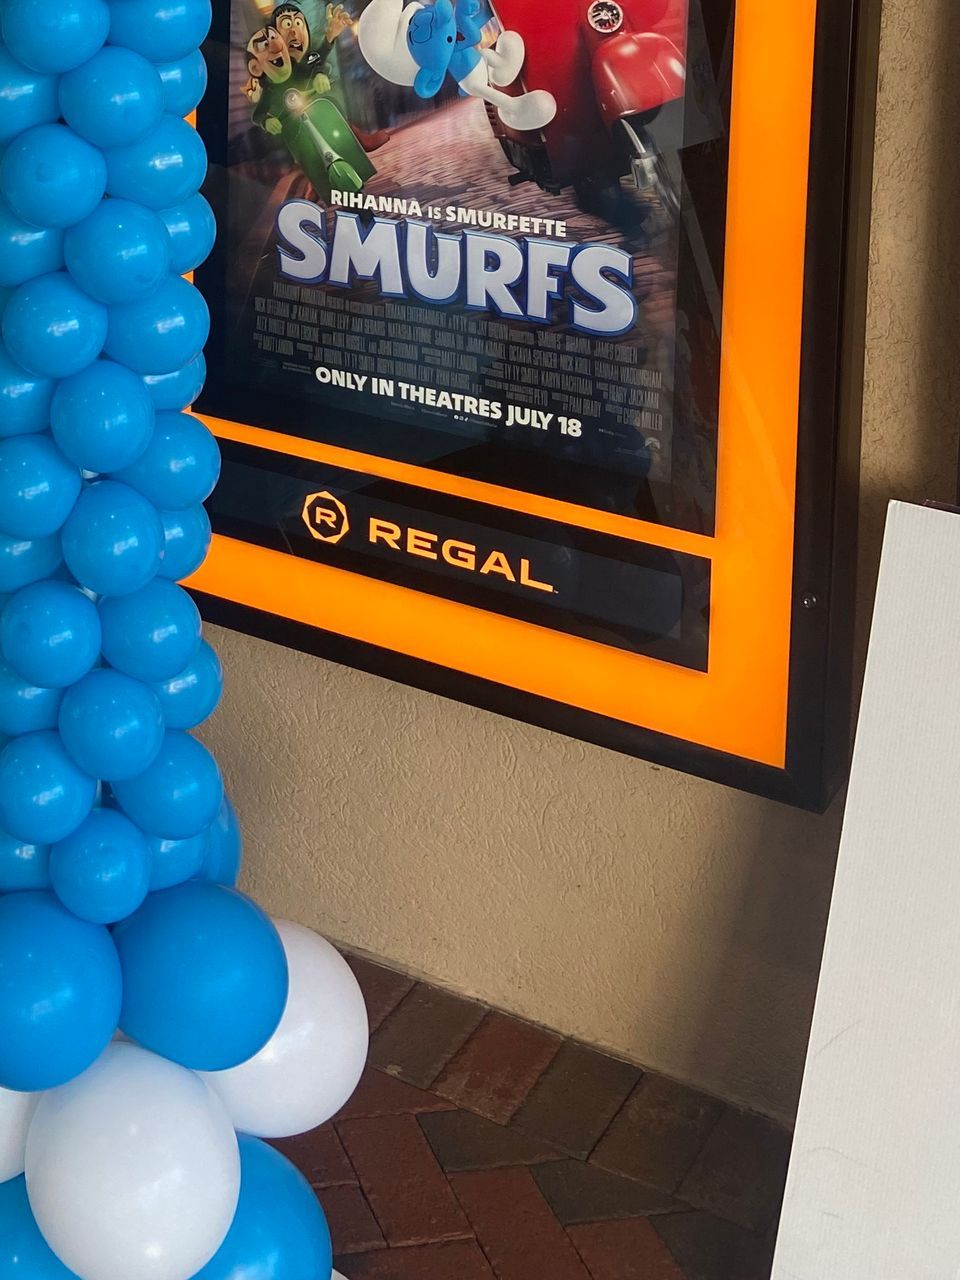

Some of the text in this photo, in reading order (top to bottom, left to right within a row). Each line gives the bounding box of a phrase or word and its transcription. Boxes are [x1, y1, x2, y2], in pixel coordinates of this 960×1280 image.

[330, 189, 422, 217] RIHANNA
[445, 206, 567, 238] SMURFETTE
[275, 198, 640, 337] SMURFS
[315, 366, 368, 391] ONLY
[371, 377, 395, 397] IN
[398, 382, 503, 420] THEATRES
[505, 404, 554, 432] JULY
[558, 416, 583, 438] 18
[369, 517, 554, 593] REGAL
